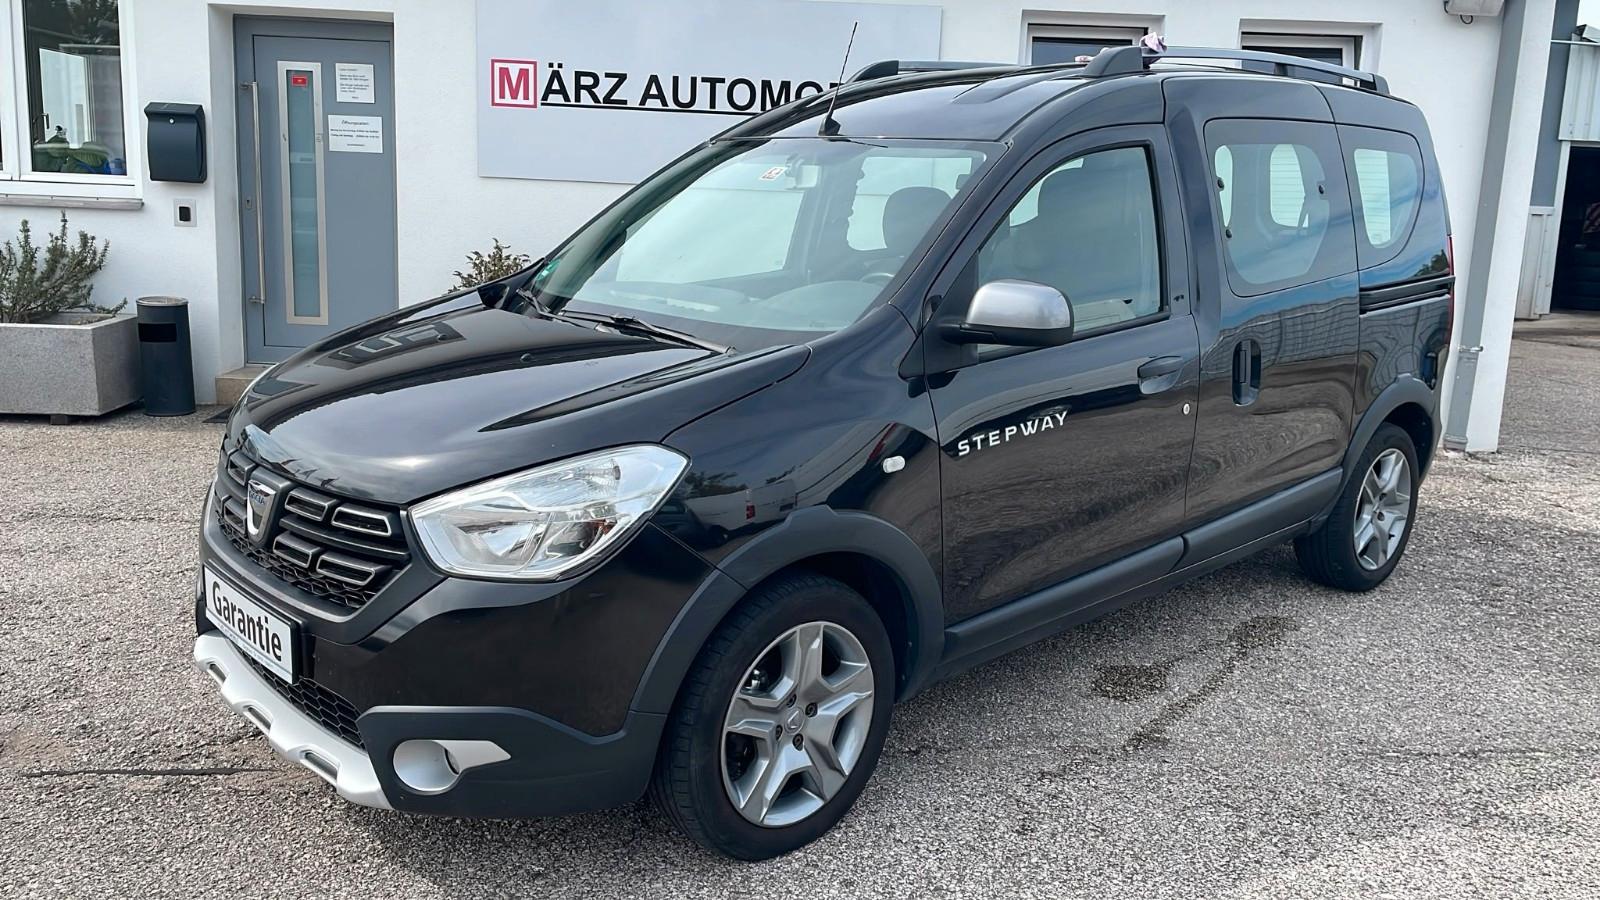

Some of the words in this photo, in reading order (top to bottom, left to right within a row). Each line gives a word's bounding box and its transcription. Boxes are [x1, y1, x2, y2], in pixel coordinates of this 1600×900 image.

[497, 62, 628, 106] MÄRZ
[638, 74, 845, 112] AUTOMO
[957, 411, 1068, 456] STEPWAY
[212, 580, 282, 662] Garantie
